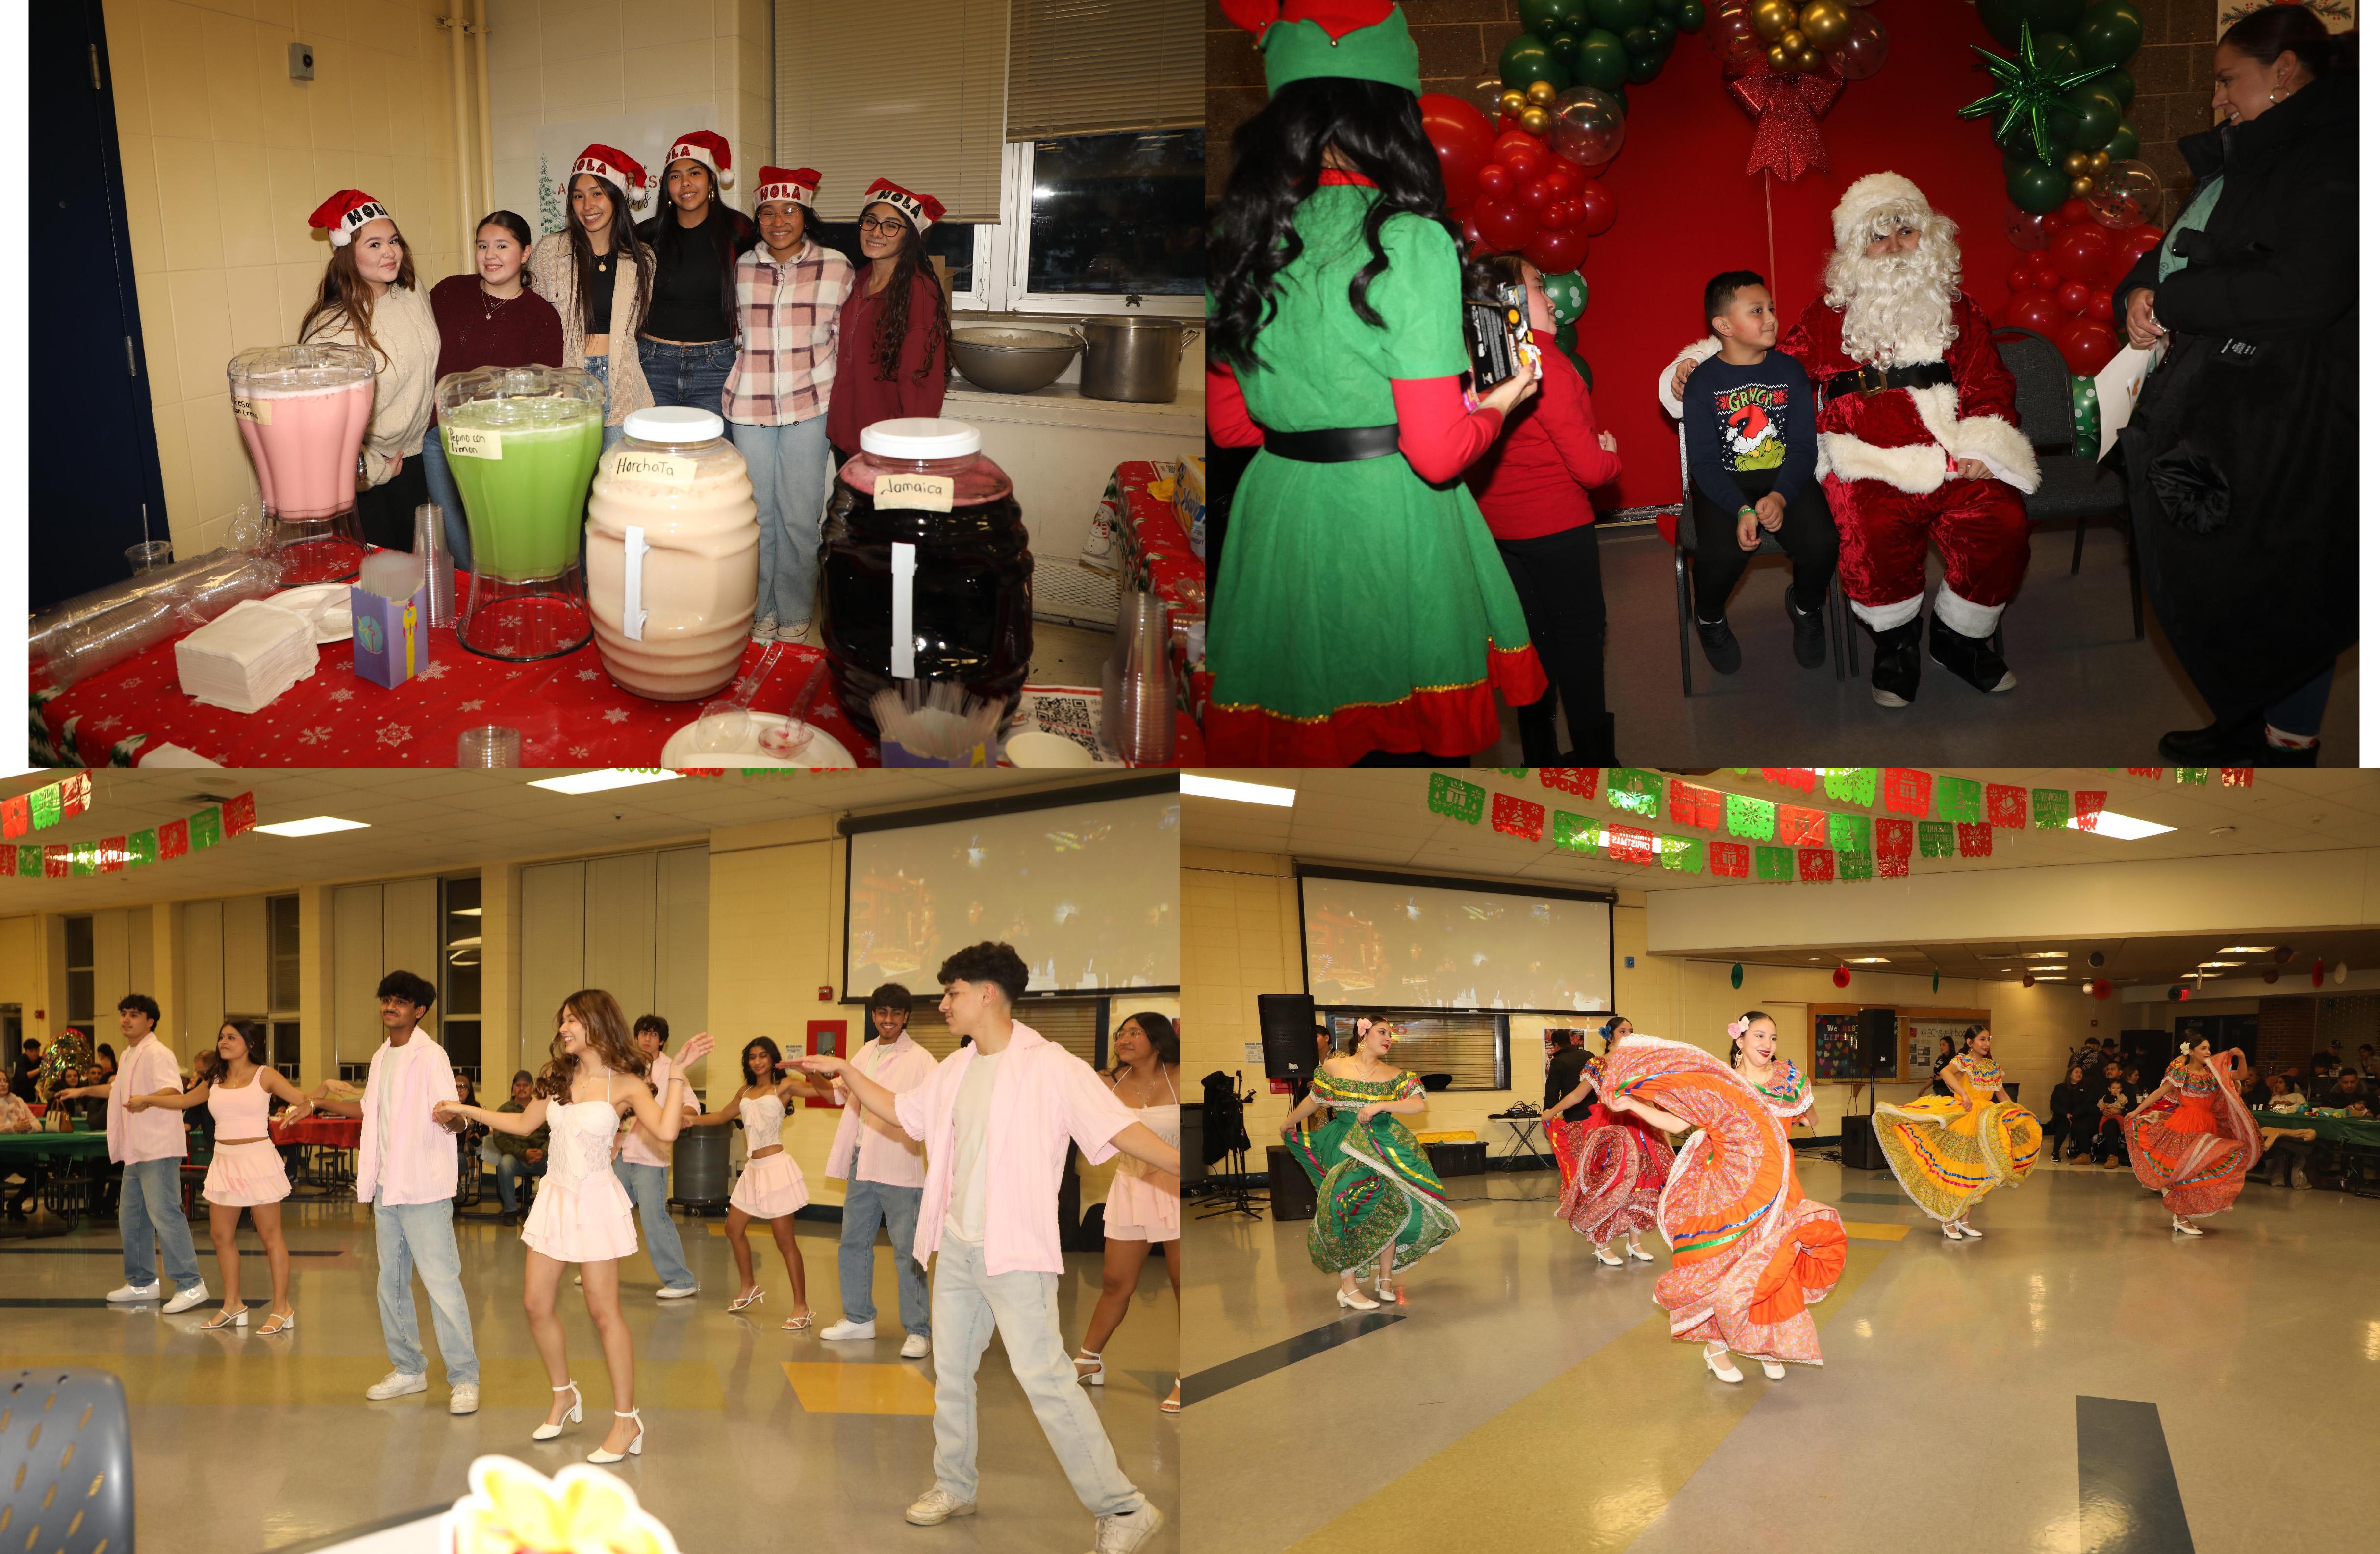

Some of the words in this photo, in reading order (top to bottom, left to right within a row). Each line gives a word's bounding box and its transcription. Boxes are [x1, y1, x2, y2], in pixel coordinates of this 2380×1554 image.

[666, 146, 690, 164] OLA
[760, 184, 801, 202] HOLA
[877, 190, 922, 219] HOLA
[347, 203, 388, 226] HOL
[1729, 387, 1772, 412] GRNCH
[448, 427, 469, 445] Pepino
[881, 479, 942, 496] Jamaica
